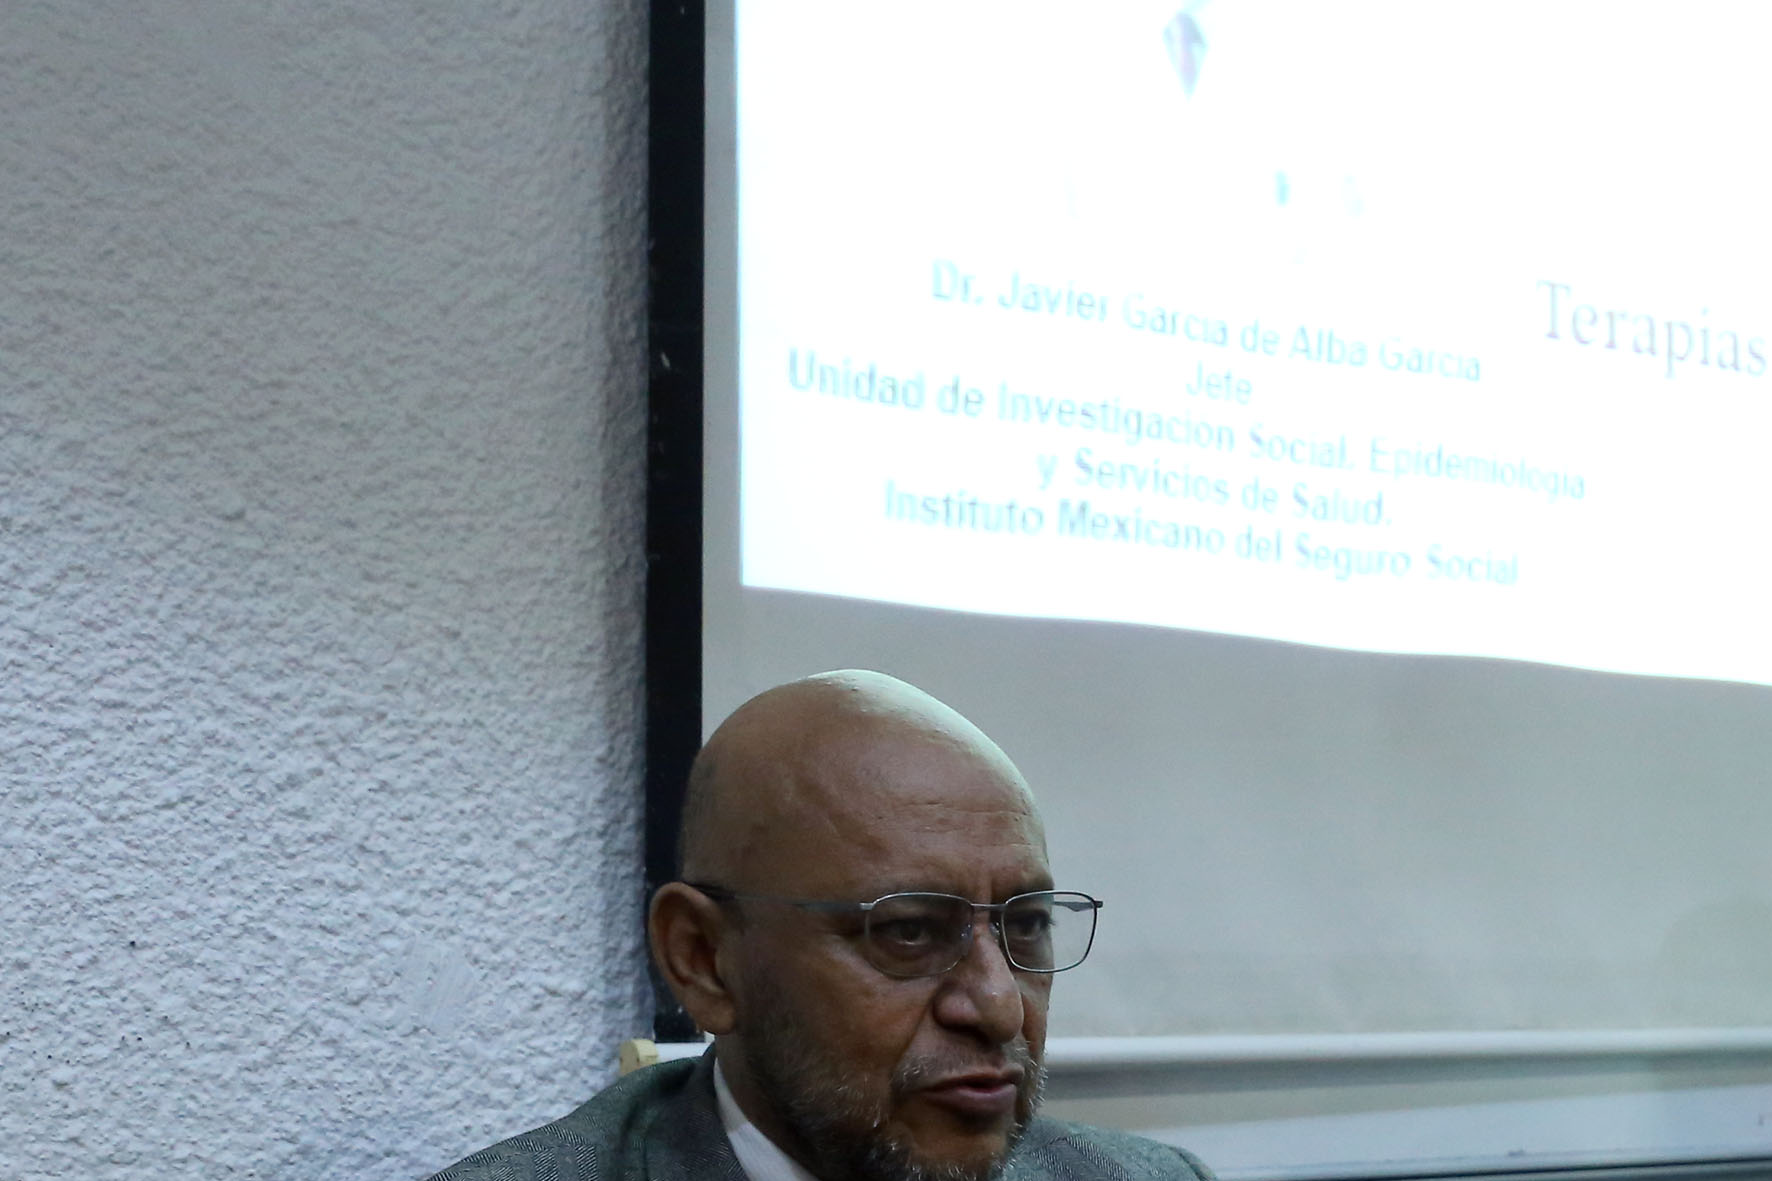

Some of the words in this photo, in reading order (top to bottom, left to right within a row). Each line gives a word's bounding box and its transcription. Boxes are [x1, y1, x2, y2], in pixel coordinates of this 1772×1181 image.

[930, 257, 985, 305] Dr.
[997, 269, 1111, 322] Javier
[1239, 317, 1281, 357] de
[1288, 324, 1368, 369] Alba
[1536, 277, 1768, 380] Terapias
[787, 346, 926, 411] Unidad
[937, 374, 986, 418] de
[884, 476, 1047, 536] Instituto
[1057, 498, 1226, 555] Mexicano
[1234, 524, 1283, 563] del
[1294, 532, 1412, 582] Seguro
[1426, 543, 1520, 586] Social
[1035, 452, 1060, 492] y
[1073, 446, 1231, 505] Servicios
[1241, 476, 1280, 514] de
